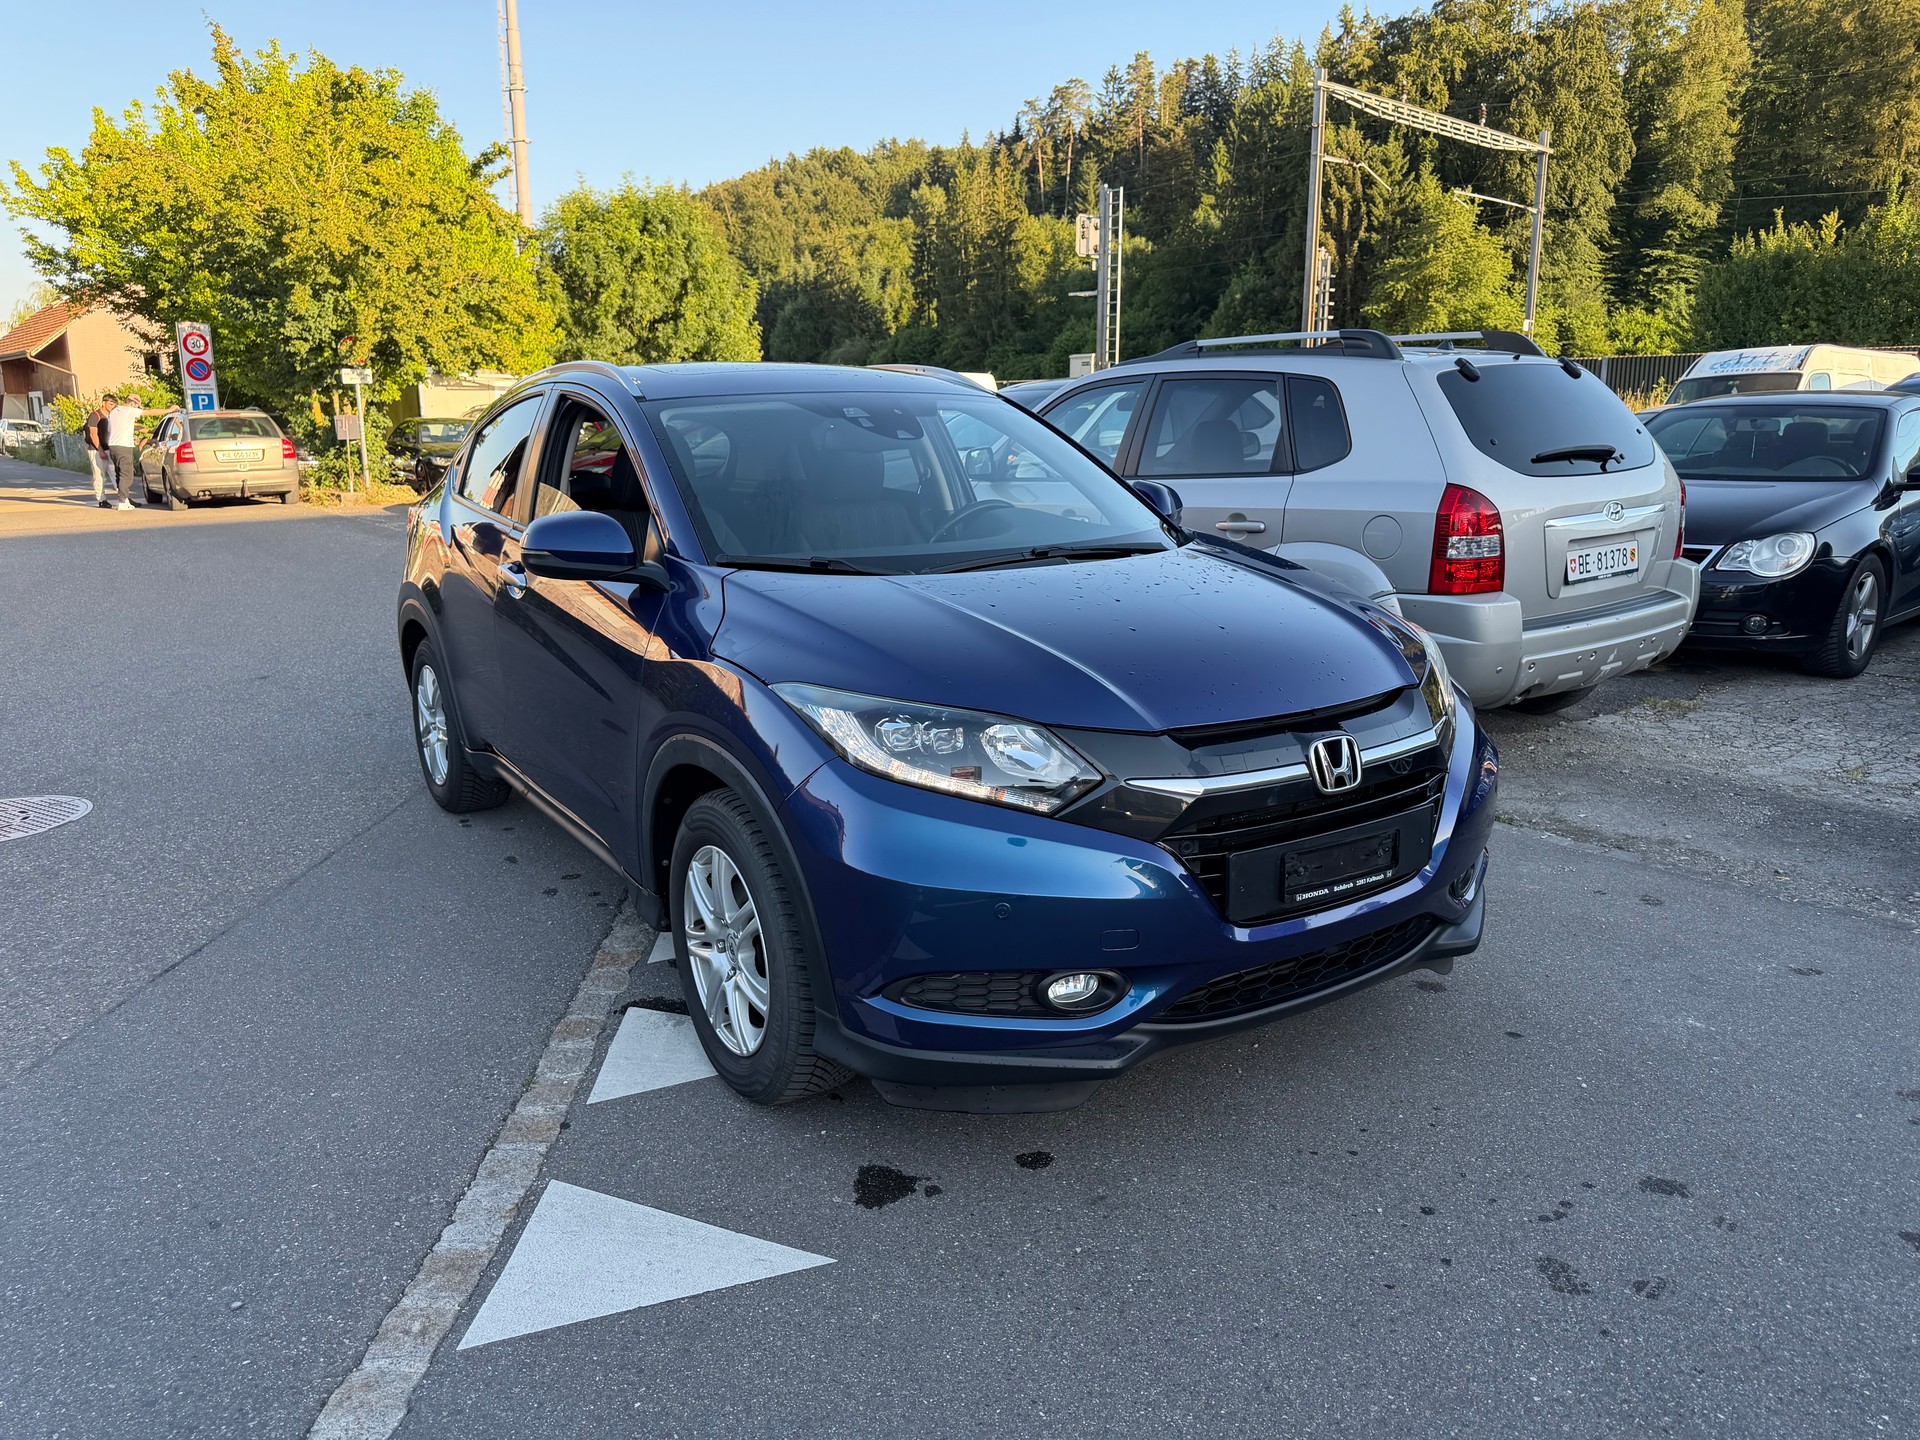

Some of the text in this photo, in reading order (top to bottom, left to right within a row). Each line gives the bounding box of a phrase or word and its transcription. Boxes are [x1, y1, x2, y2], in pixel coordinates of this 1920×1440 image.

[190, 339, 201, 349] 30
[198, 395, 209, 410] P
[1302, 888, 1329, 899] HONDA
